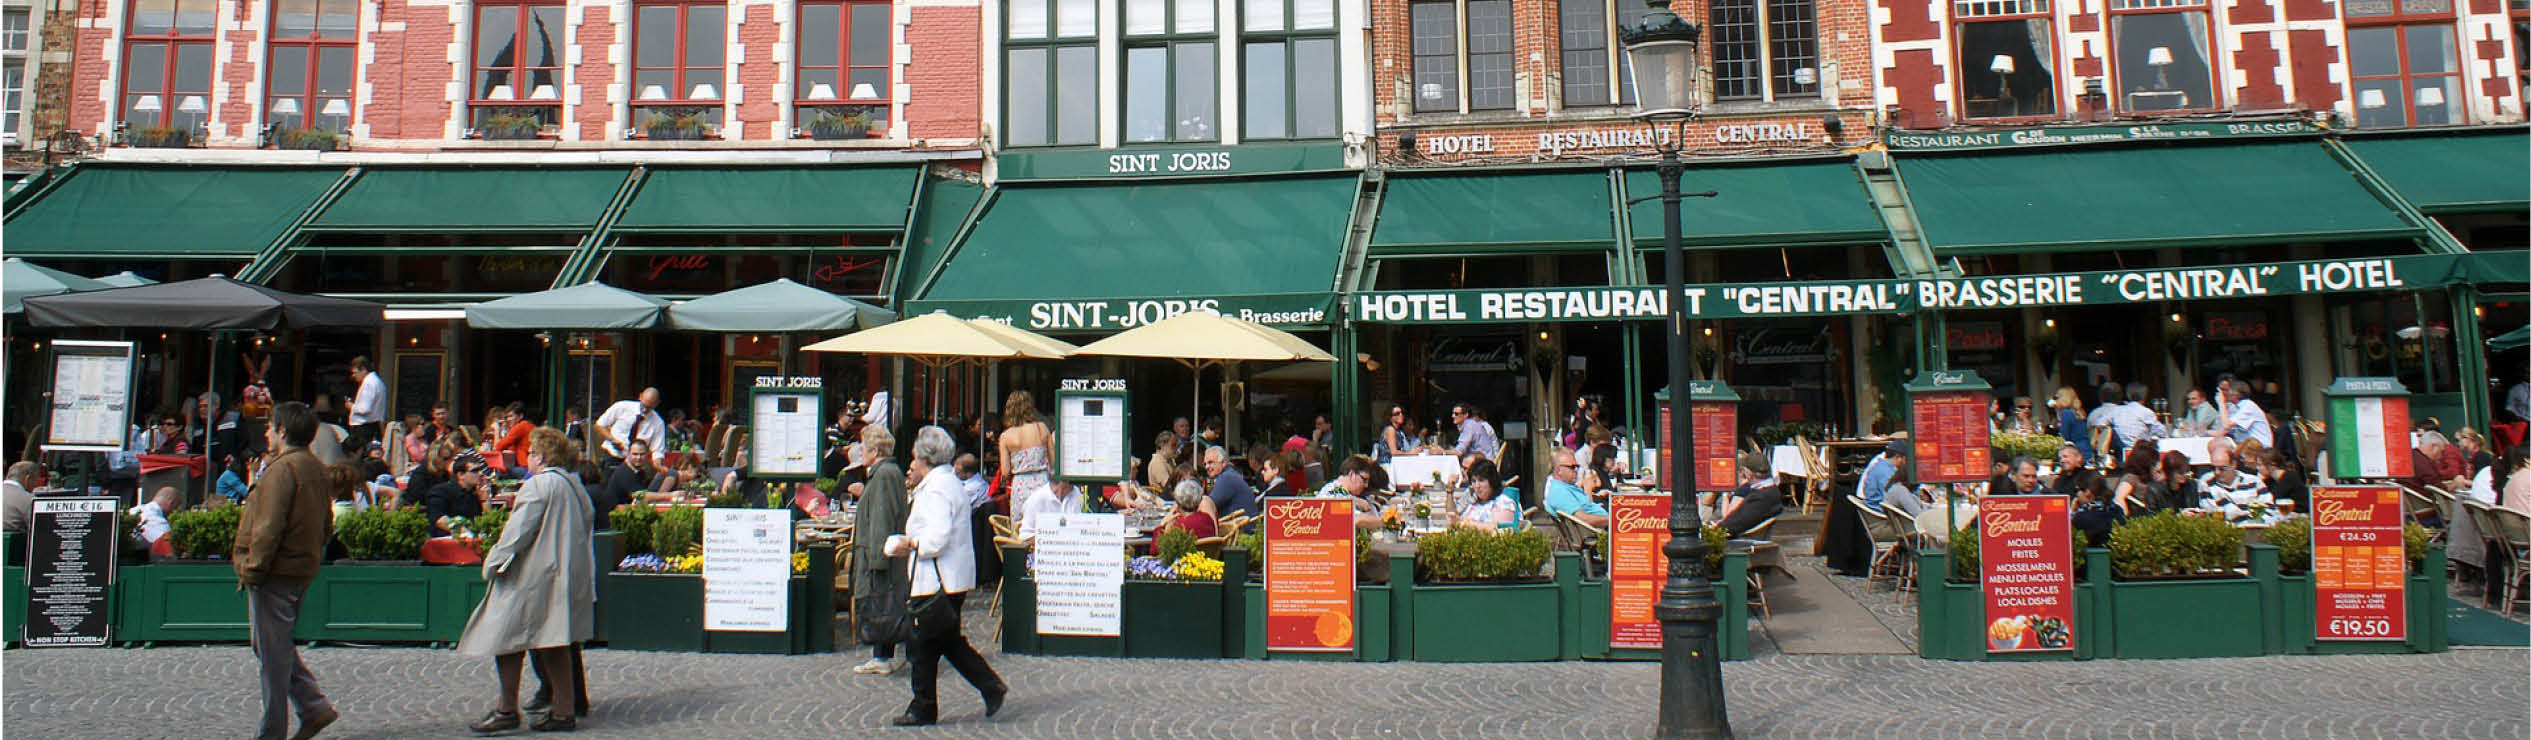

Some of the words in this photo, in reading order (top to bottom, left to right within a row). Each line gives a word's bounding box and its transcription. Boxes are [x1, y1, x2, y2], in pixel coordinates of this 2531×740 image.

[1429, 134, 1494, 154] HOTEL
[1538, 127, 1673, 152] RESTAURANT
[1715, 122, 1810, 143] CENTRAL
[1889, 133, 2000, 148] RESTAURANT
[1109, 154, 1160, 173] SINT
[1167, 152, 1231, 172] JORIS
[1918, 275, 2083, 308] BRASSERIE
[2299, 259, 2403, 292] HOTEL
[1360, 292, 1467, 321] HOTEL
[1722, 281, 1910, 314] "CENTRAL"
[1239, 307, 1324, 324] Brasserie
[755, 376, 784, 388] SINT
[786, 376, 822, 388] JORIS
[1061, 379, 1089, 390] SINT
[1092, 378, 1126, 390] JORIS
[46, 502, 76, 511] MENU
[1268, 500, 1326, 520] Hotel
[2317, 500, 2375, 526] Central
[1282, 519, 1322, 537] Central
[1615, 508, 1669, 533] Centra
[1985, 512, 2042, 537] Central
[2007, 538, 2043, 547] MOULES
[2339, 532, 2377, 541] €24.50
[2011, 549, 2040, 559] FRITES
[1995, 562, 2056, 572] MOSSELMENU
[1988, 575, 2015, 584] MENU
[2015, 574, 2027, 583] DE
[2028, 573, 2064, 583] MOULES
[1994, 587, 2019, 596] PLATS
[2019, 586, 2059, 595] LOCALES
[1997, 598, 2026, 607] LOCAL
[2027, 597, 2057, 606] DISHES
[2330, 620, 2390, 635] €19.50
